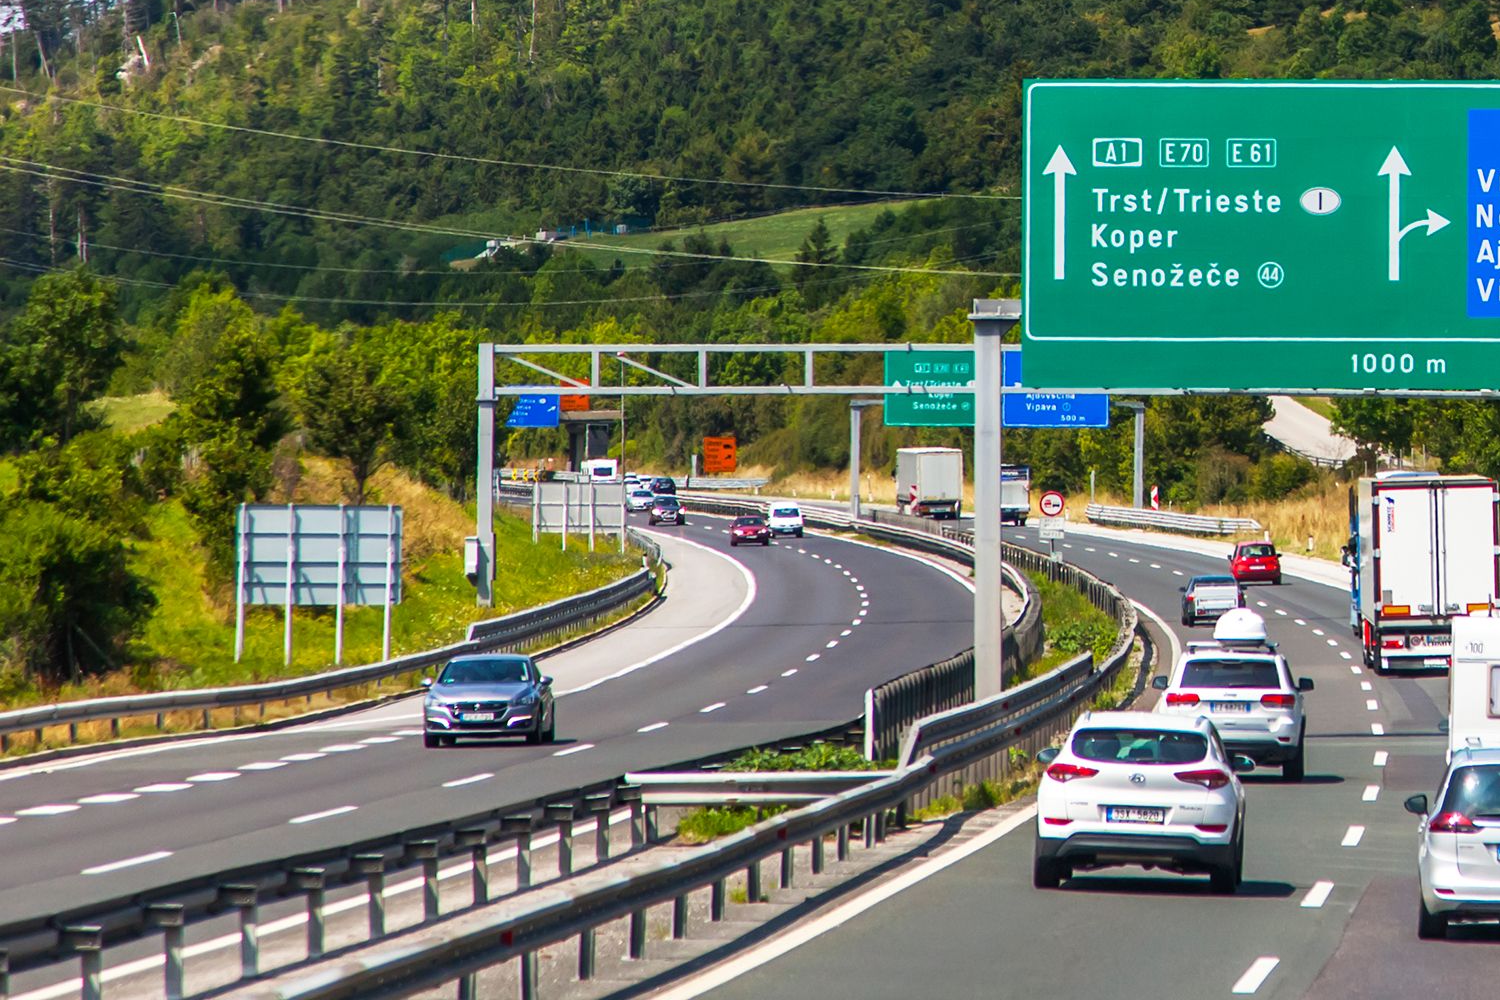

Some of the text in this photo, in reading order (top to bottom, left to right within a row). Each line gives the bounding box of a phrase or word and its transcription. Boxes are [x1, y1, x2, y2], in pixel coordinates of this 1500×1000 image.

[1105, 142, 1127, 162] A1
[1092, 187, 1281, 215] Trst/Trieste
[1091, 223, 1178, 254] Koper
[1091, 262, 1279, 287] Senožeče 44
[1351, 353, 1446, 373] 1000 m
[1026, 402, 1057, 412] Vipava
[1060, 414, 1077, 422] 500
[1469, 642, 1484, 654] 100
